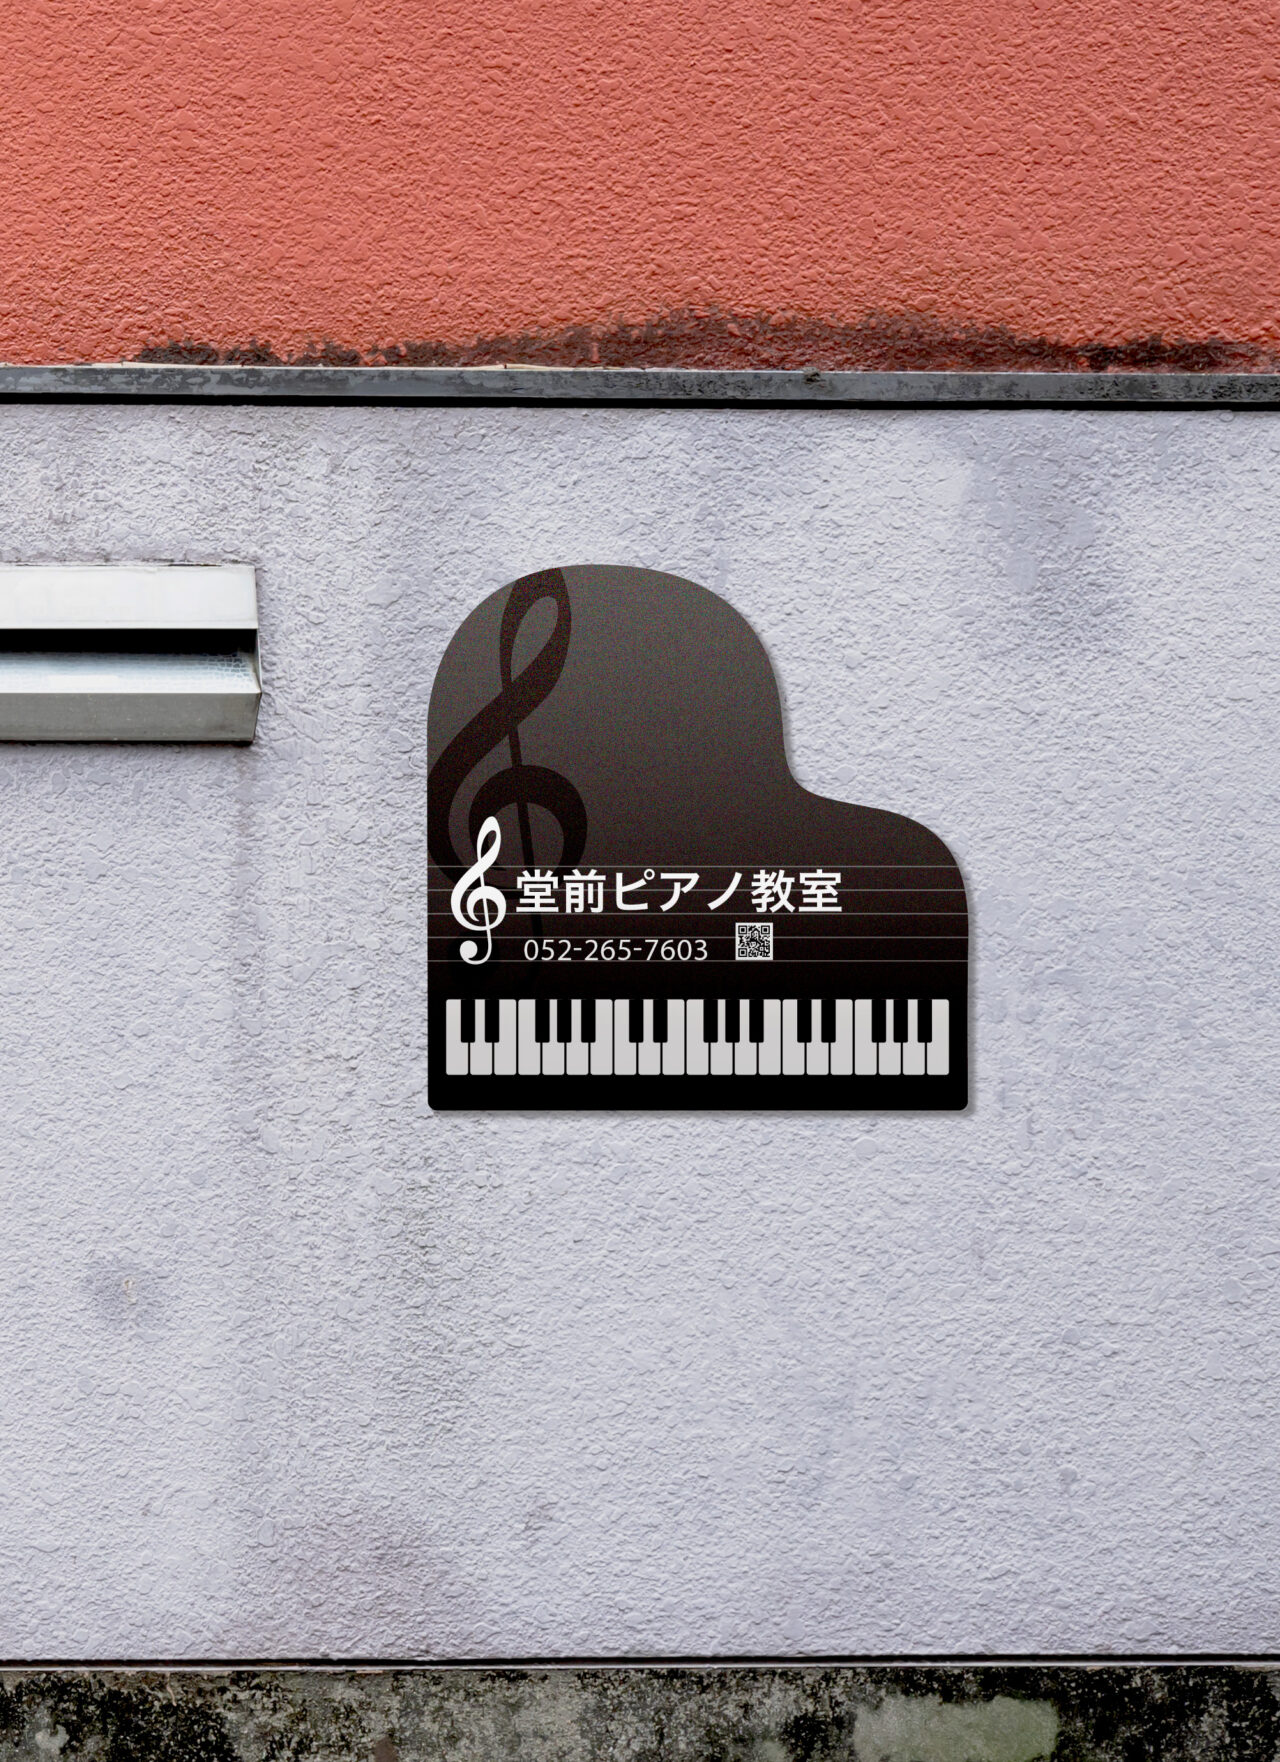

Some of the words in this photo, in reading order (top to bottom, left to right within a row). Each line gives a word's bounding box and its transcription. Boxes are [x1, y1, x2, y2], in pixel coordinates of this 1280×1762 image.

[515, 868, 843, 914] 堂前ピアノ教室
[522, 938, 709, 962] 052-265-7603
